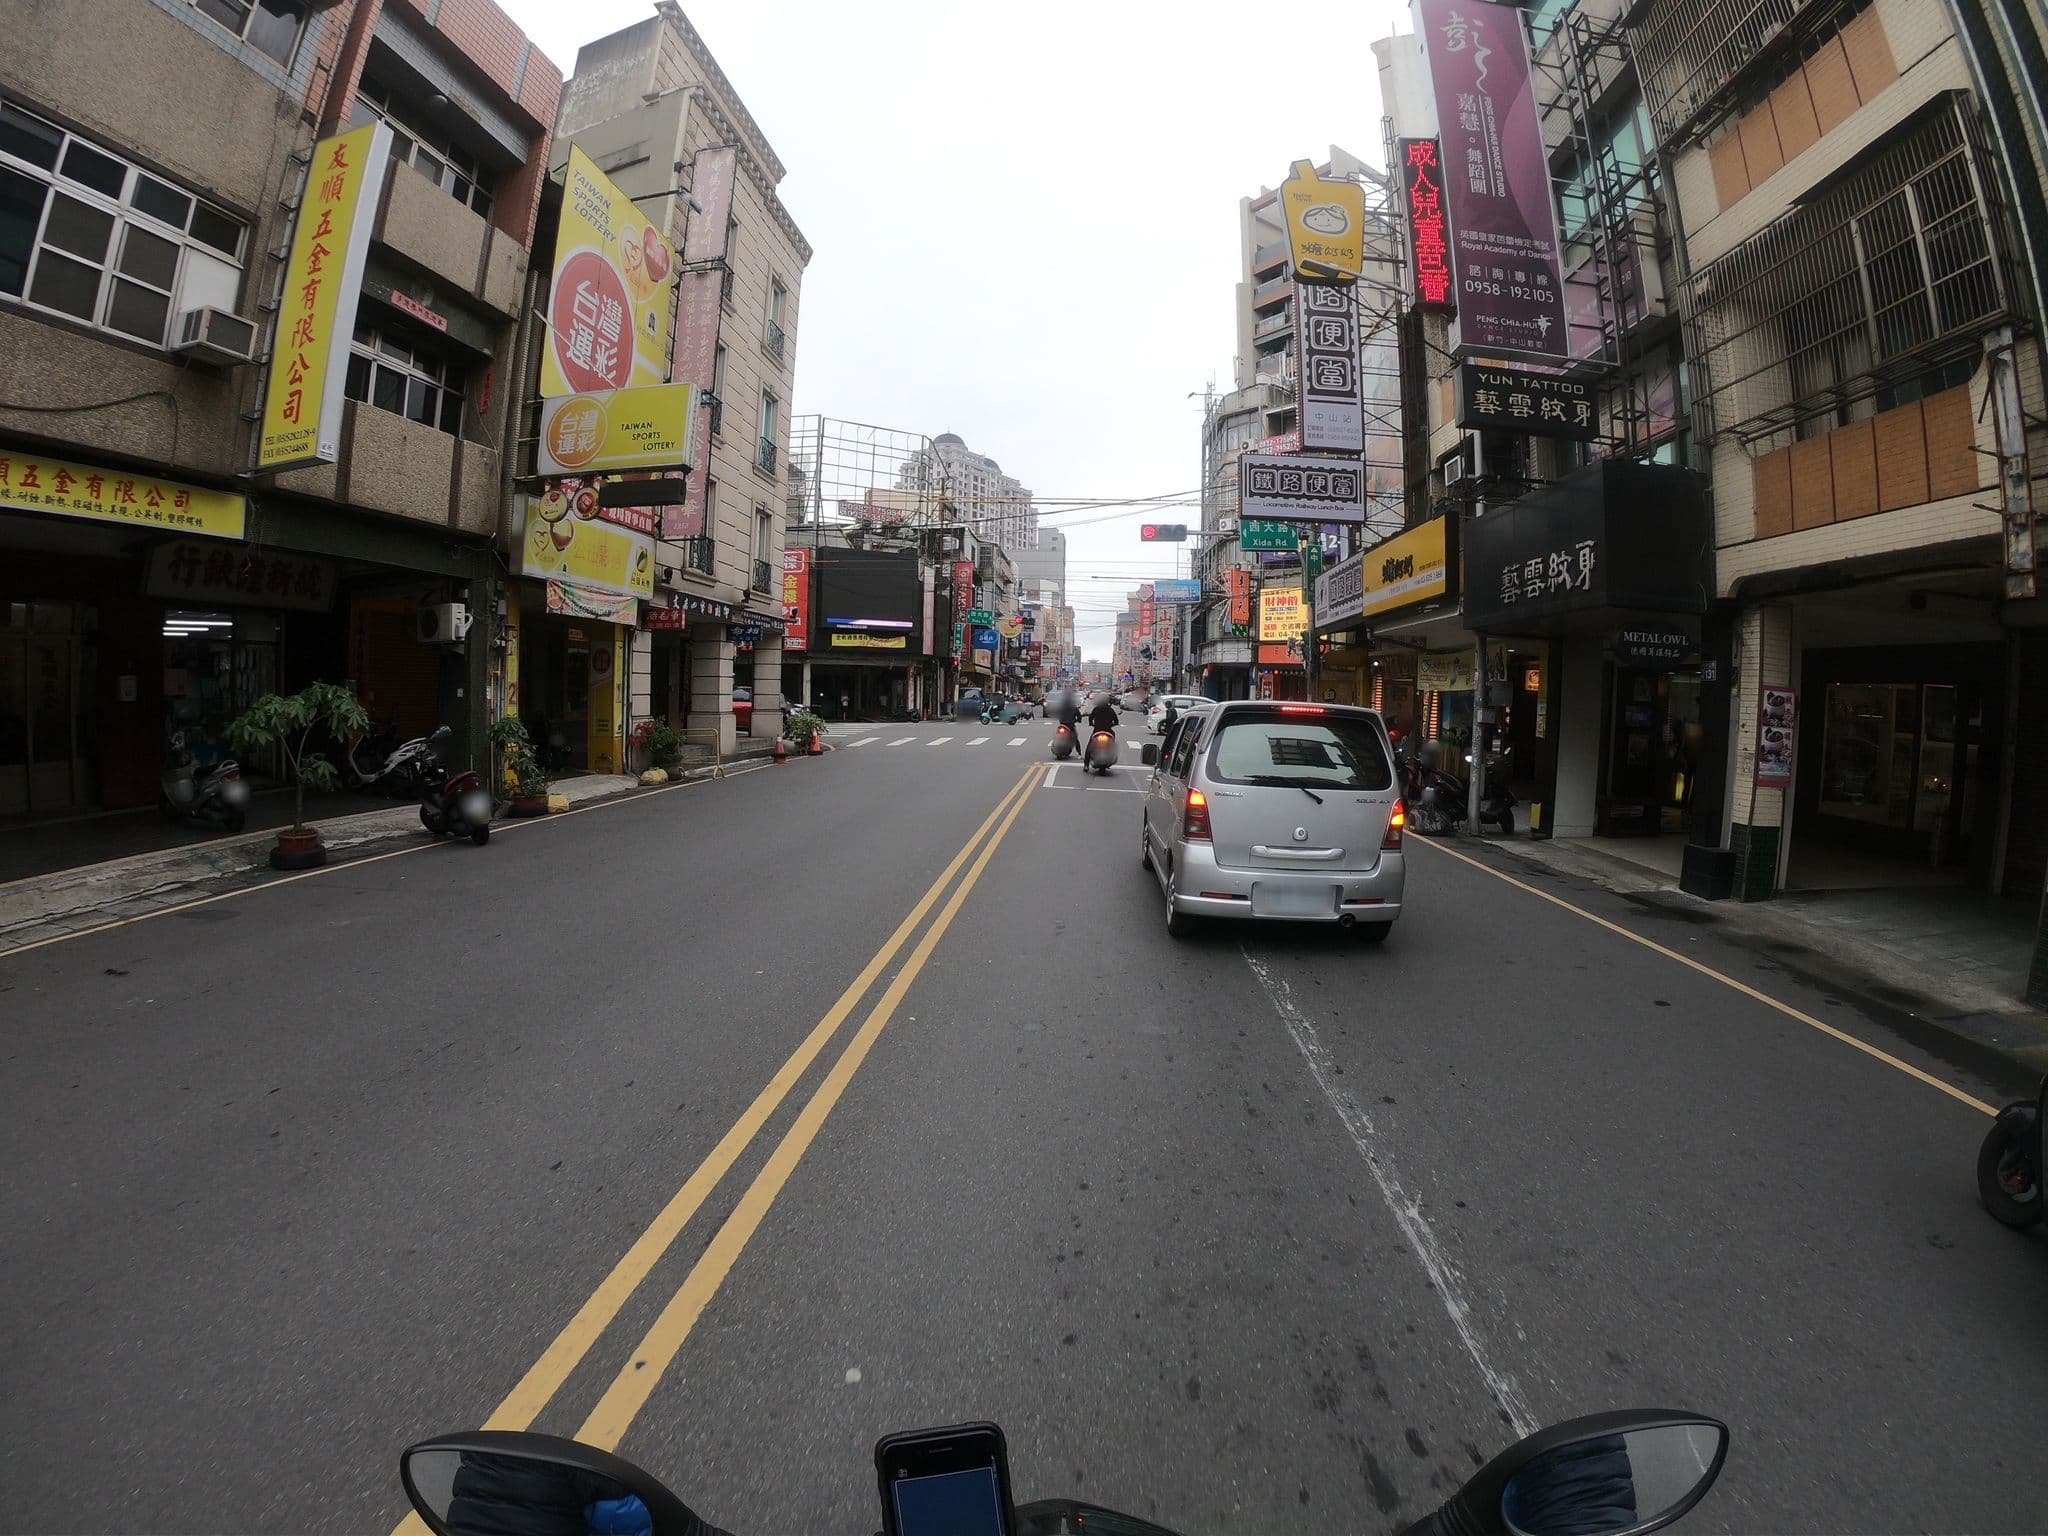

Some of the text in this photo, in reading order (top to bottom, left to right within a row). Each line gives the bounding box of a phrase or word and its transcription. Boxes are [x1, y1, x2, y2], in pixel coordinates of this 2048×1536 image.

[573, 170, 612, 209] TAIWAN
[571, 188, 611, 224] SPORTS
[574, 204, 617, 243] LOTTERY
[1461, 241, 1482, 252] Royal
[1484, 245, 1517, 257] Academy
[282, 143, 350, 425] 友順五金有限公司
[1465, 280, 1554, 303] 0958-192105
[1476, 315, 1498, 324] PENG
[1478, 373, 1584, 395] YUN TATTOO
[1315, 411, 1351, 423] 中山站
[621, 422, 653, 432] TAIWAN
[632, 431, 661, 441] SPORTS
[643, 440, 675, 451] LOTTERY
[1253, 472, 1352, 496] 鐵路便當
[1249, 521, 1288, 533] 西大路
[1623, 631, 1689, 646] METAL OWL
